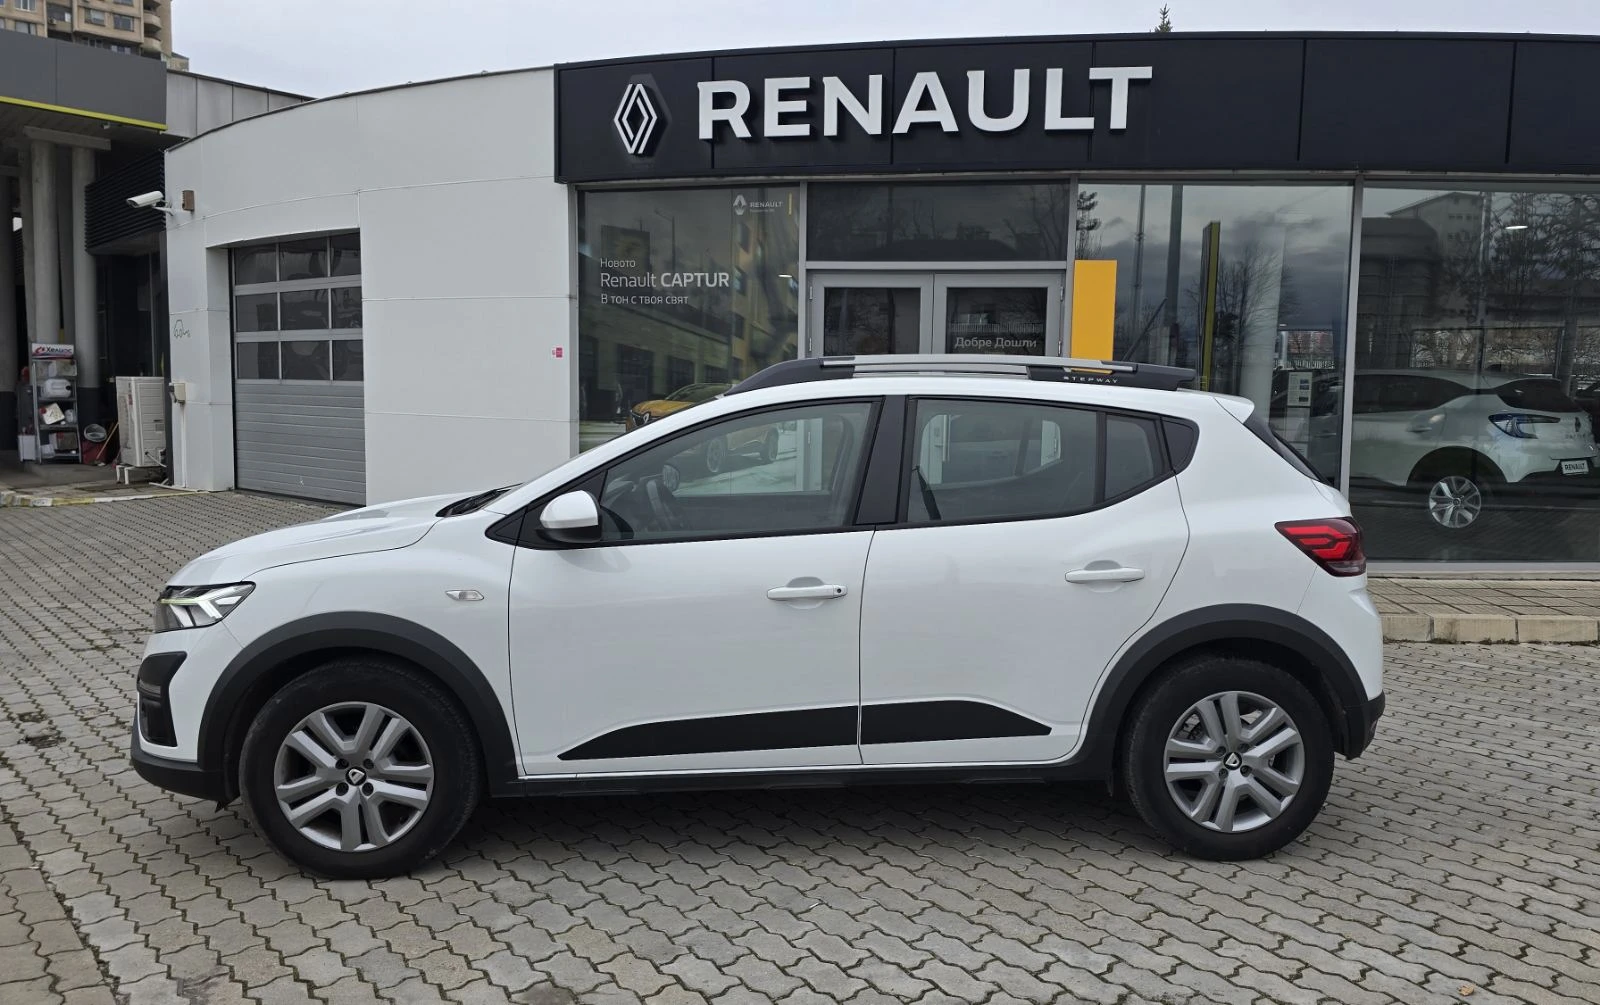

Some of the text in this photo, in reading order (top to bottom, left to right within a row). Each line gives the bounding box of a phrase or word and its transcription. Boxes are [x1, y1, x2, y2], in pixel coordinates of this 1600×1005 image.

[697, 66, 1153, 140] RENAULT
[600, 258, 636, 268] Новото
[600, 272, 730, 287] Renault CAPTUR
[601, 294, 689, 304] В тон с твоя свят
[954, 337, 1037, 349] Добре Дошли
